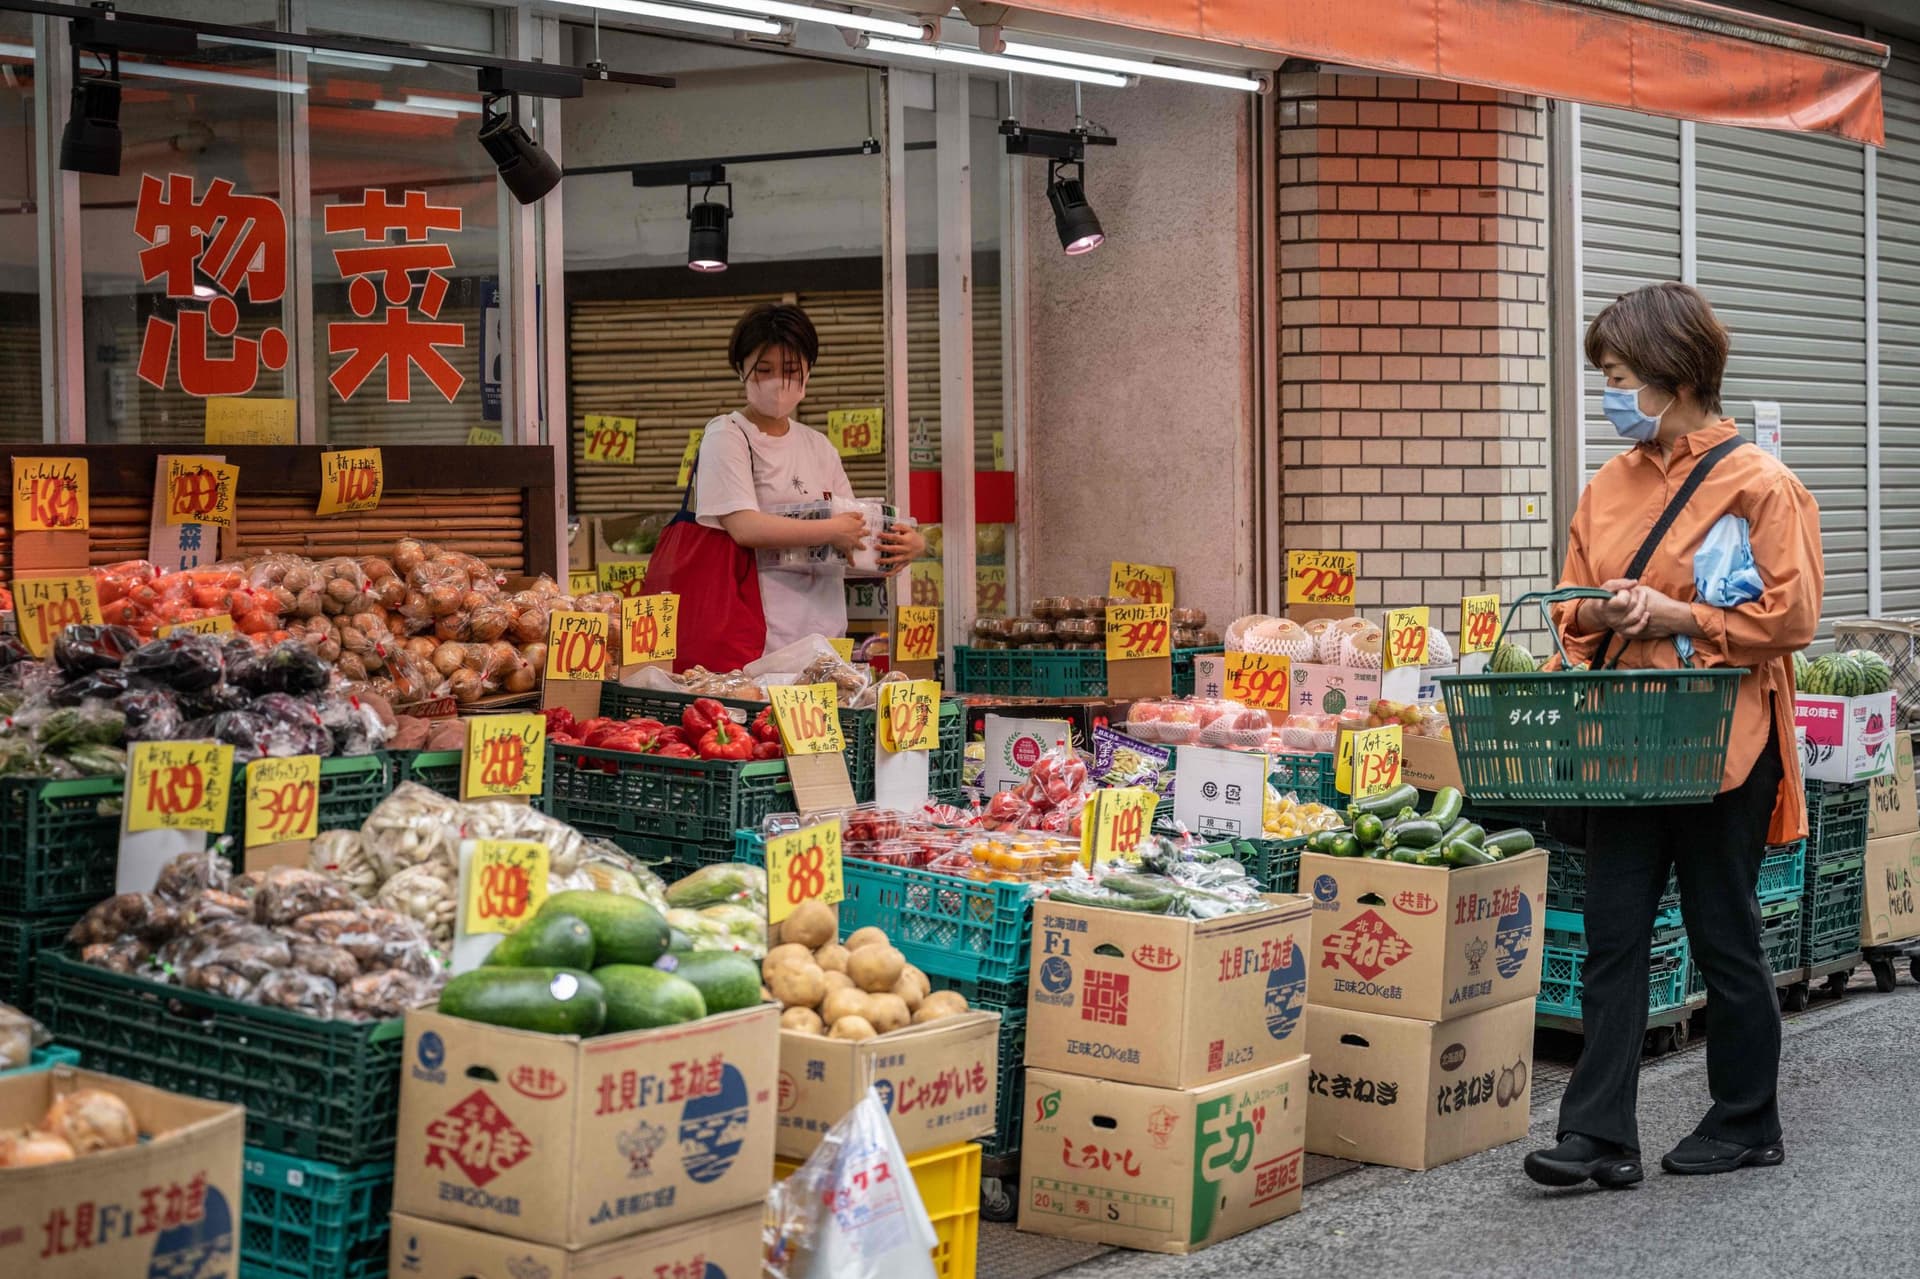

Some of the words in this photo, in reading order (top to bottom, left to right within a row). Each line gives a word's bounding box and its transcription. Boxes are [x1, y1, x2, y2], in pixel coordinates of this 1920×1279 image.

[134, 172, 466, 404] 惣菜
[589, 429, 628, 457] 199
[1300, 567, 1354, 597] 790
[905, 609, 937, 623] さくらんぼ
[1394, 612, 1419, 627] プラム
[556, 631, 606, 673] 100
[904, 623, 935, 655] 499
[1117, 619, 1168, 653] 399
[1391, 625, 1426, 662] 399
[1242, 654, 1269, 671] もも
[891, 683, 916, 703] トマト
[1233, 668, 1288, 706] 599
[1300, 690, 1313, 706] 共
[790, 704, 827, 741] 160
[1509, 708, 1561, 726] ダイイチ
[1360, 749, 1400, 790] 139
[257, 780, 316, 835] 399
[1110, 805, 1143, 852] 199
[787, 844, 826, 905] 88
[1885, 867, 1912, 891] KUMA
[1399, 890, 1432, 910] 共計
[1888, 892, 1915, 916] MOTO
[1043, 915, 1089, 933] 北海道産
[1354, 920, 1384, 934] 北見
[1043, 930, 1072, 957] F1
[1138, 944, 1175, 966] 共計
[1321, 929, 1414, 968] 玉ねぎ
[897, 1060, 989, 1116] じゃがいも
[1308, 1068, 1399, 1107] たまねぎ
[1437, 1069, 1496, 1117] たまねぎ
[1062, 1136, 1142, 1178] しろいし
[1254, 1155, 1300, 1197] たまねぎ
[1034, 1193, 1050, 1209] 20
